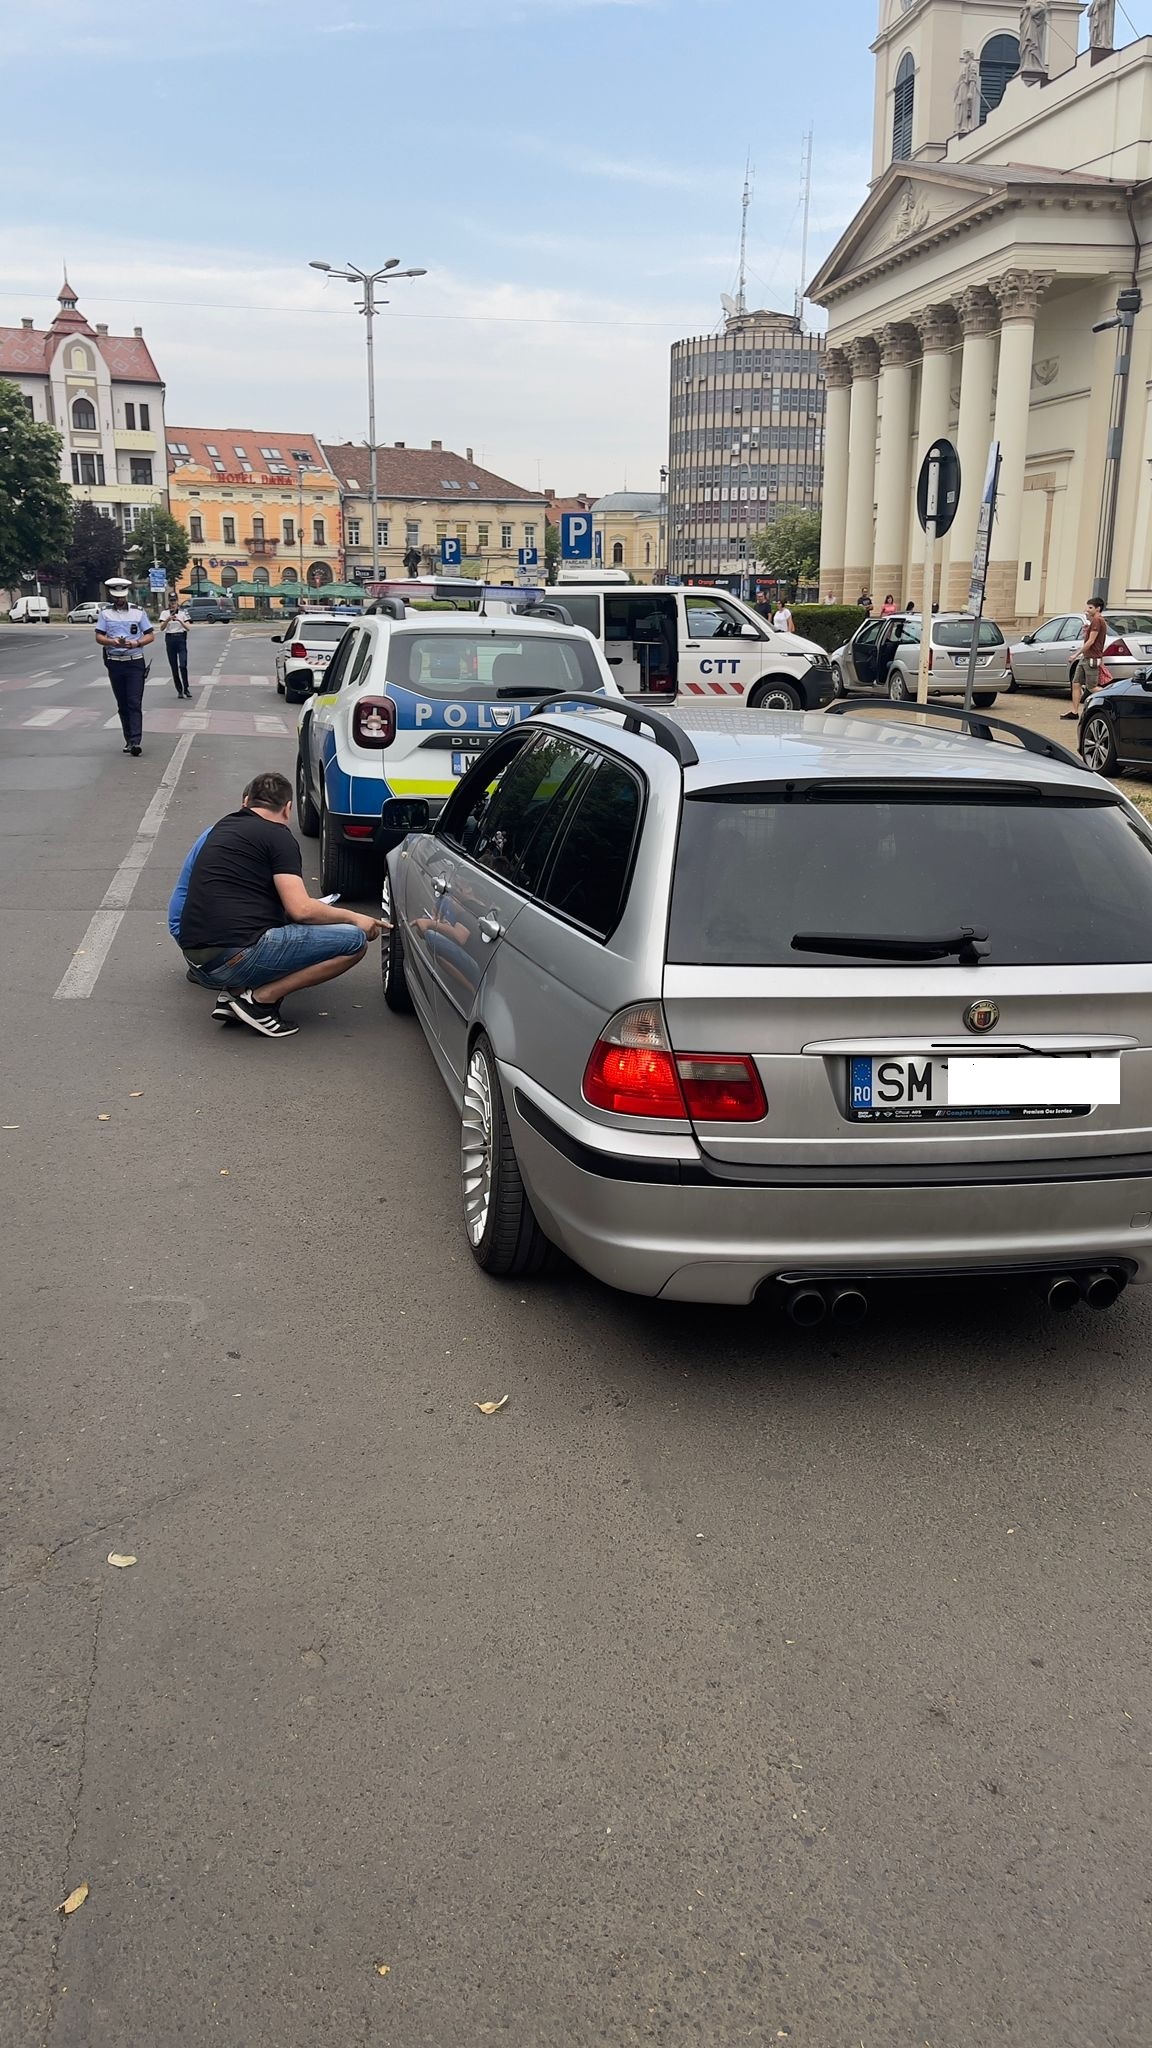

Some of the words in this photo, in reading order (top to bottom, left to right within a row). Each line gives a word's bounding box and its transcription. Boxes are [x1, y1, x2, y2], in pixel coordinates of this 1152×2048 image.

[217, 473, 256, 485] HOTEL
[262, 475, 292, 485] DANA
[569, 517, 587, 546] P
[445, 540, 457, 559] P
[523, 549, 533, 564] P
[700, 659, 740, 674] CTT
[854, 1086, 871, 1102] RO
[877, 1062, 932, 1102] SM
